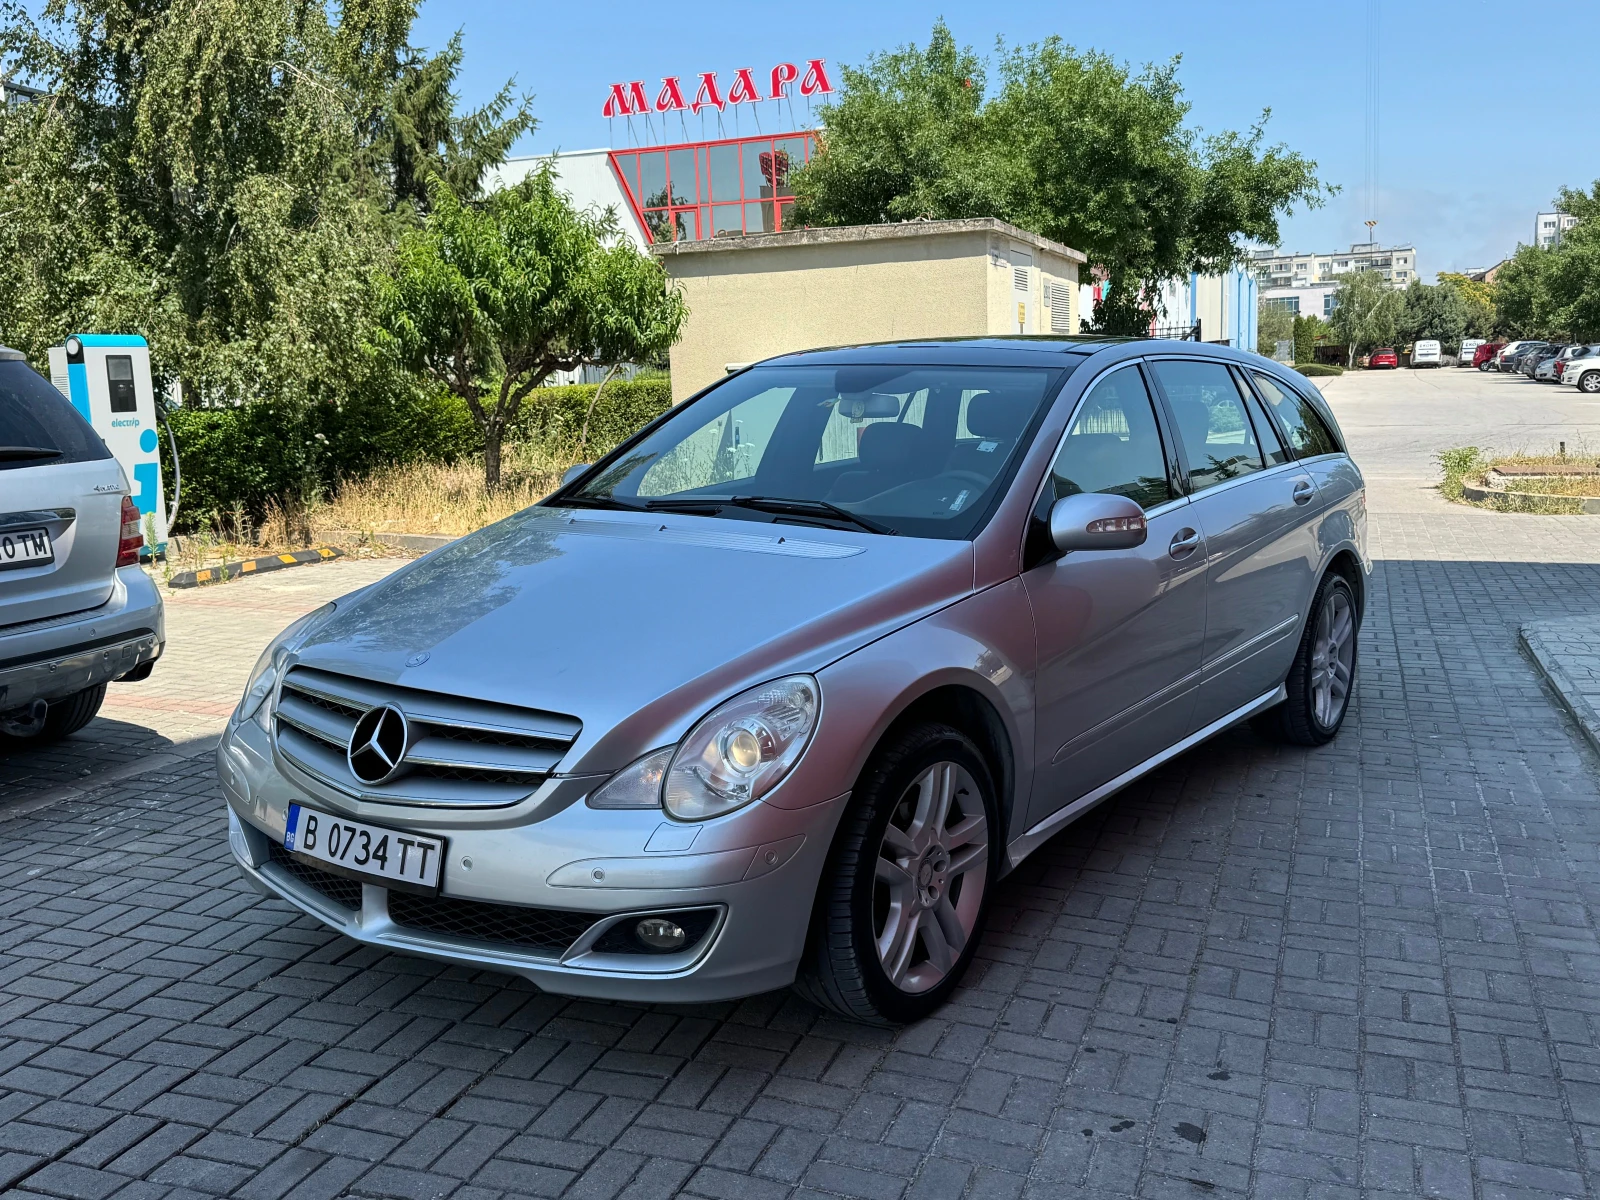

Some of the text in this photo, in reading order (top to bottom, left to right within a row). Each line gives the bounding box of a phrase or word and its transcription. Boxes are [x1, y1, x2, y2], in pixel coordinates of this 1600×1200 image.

[602, 58, 836, 117] МАДАРА
[111, 417, 140, 428] electrip
[0, 532, 47, 560] 0 TM
[286, 831, 295, 843] BG
[303, 815, 435, 879] B 0734 TT
